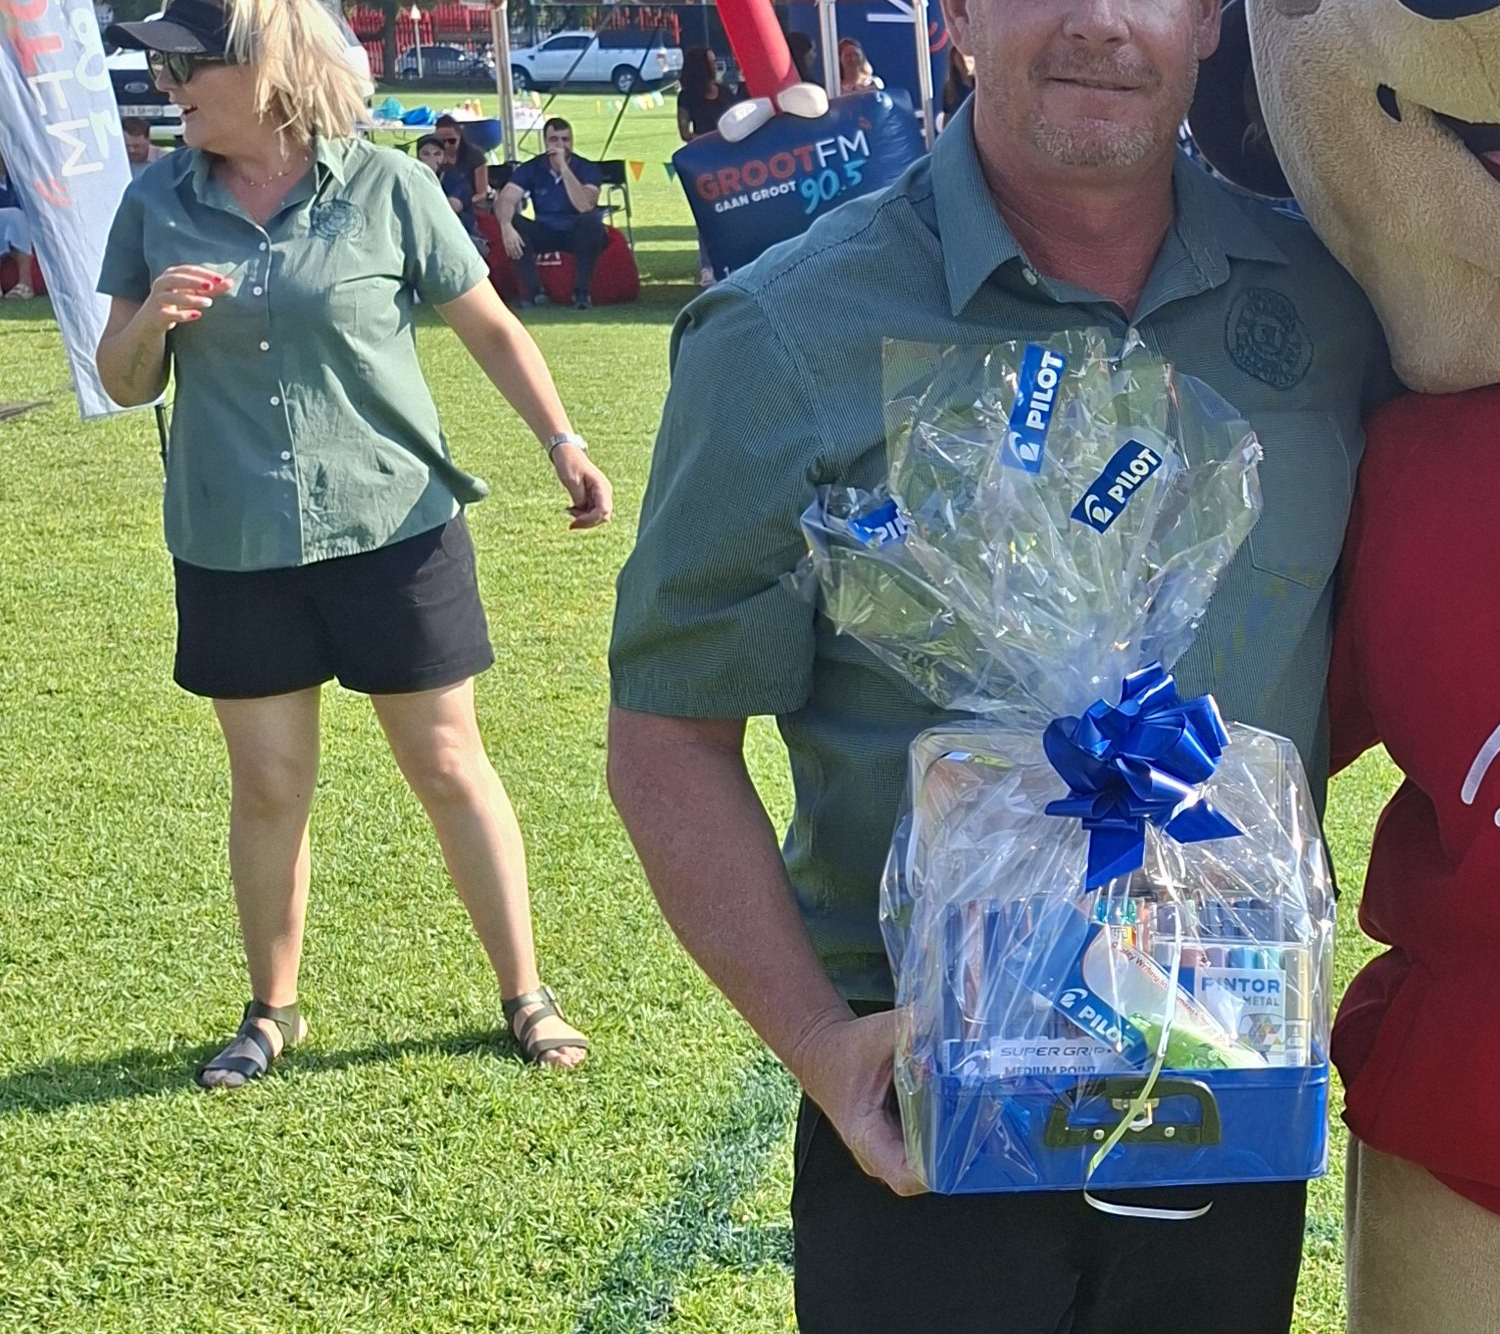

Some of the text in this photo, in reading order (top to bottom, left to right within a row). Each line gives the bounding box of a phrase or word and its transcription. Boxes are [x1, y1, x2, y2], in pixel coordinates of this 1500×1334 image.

[714, 180, 798, 213] GAAN GROOT
[1026, 351, 1063, 431] PILOT
[1107, 448, 1158, 504] PILOT
[1000, 1047, 1060, 1057] SUPER
[1078, 1005, 1137, 1053] PILOT
